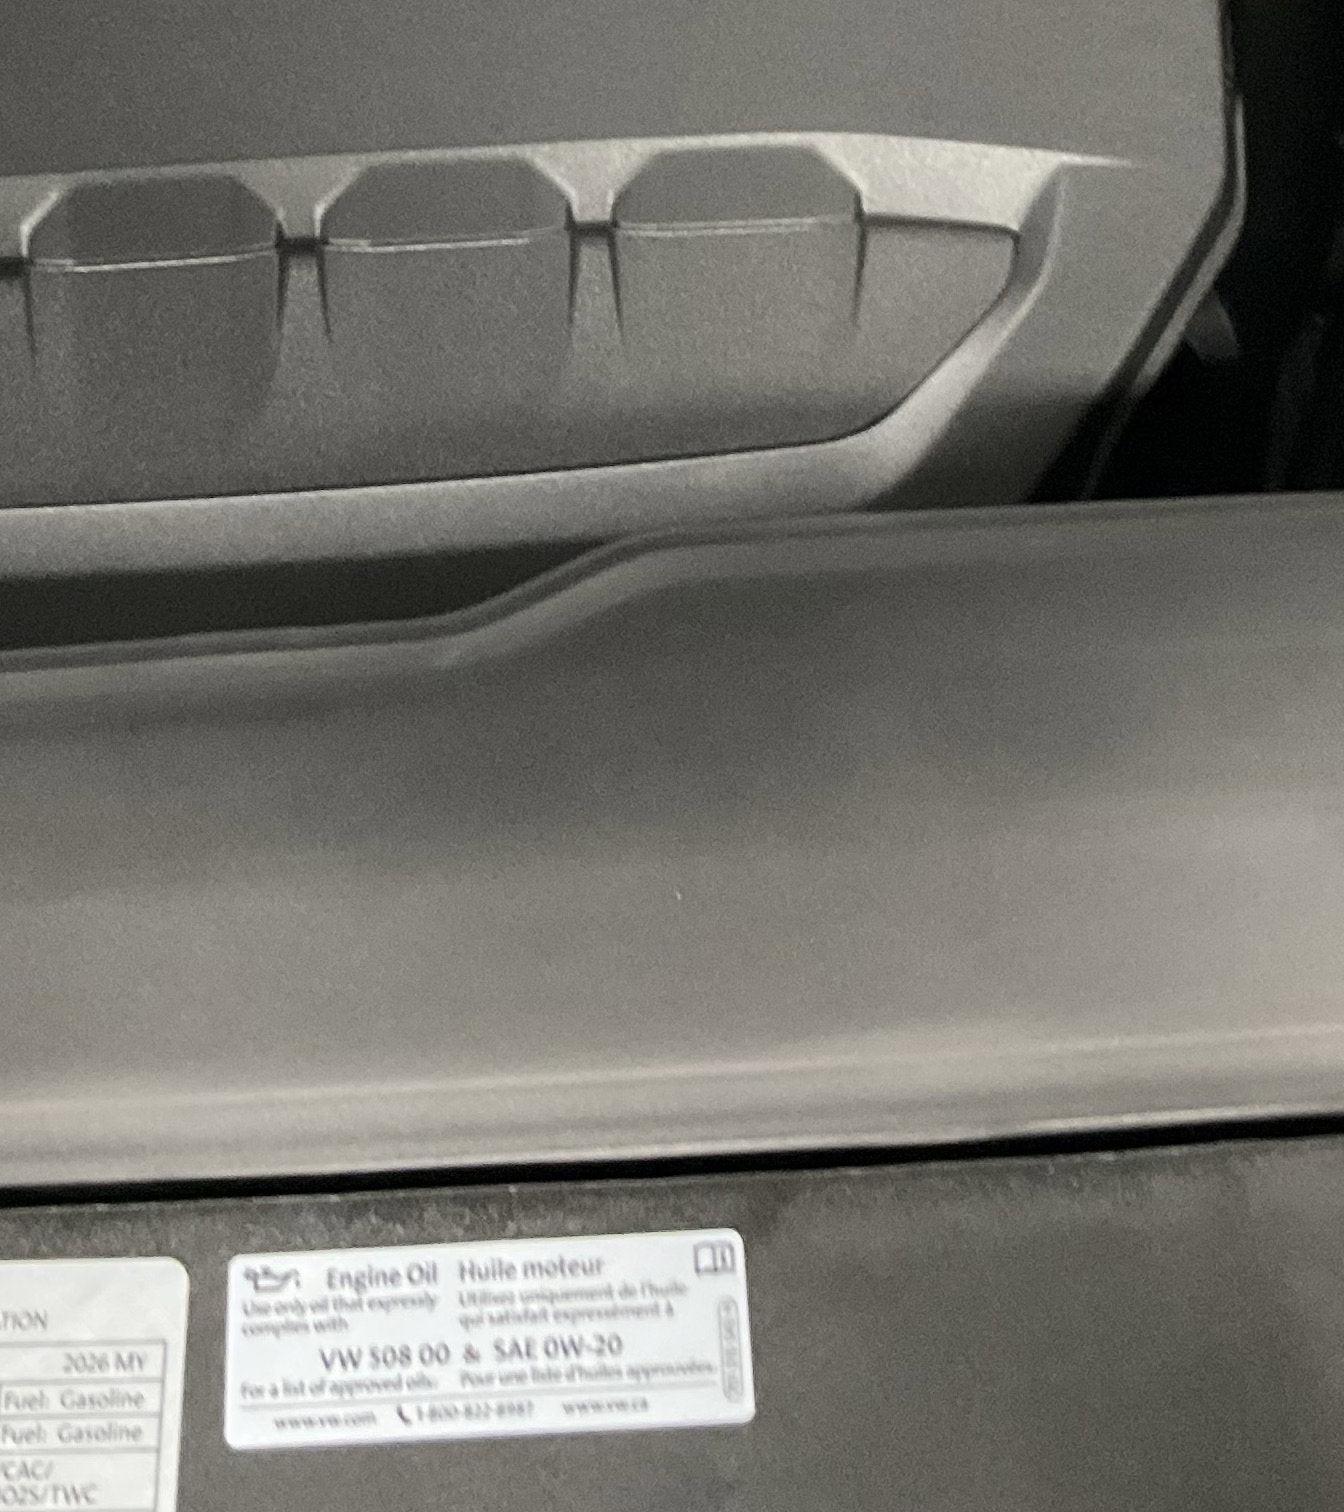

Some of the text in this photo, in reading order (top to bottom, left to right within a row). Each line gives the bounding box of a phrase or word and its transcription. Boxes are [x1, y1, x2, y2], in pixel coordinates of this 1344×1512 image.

[328, 1261, 437, 1295] Engine Oil
[459, 1251, 601, 1283] Huile moteur
[113, 1351, 148, 1372] MY
[319, 1332, 622, 1372] VW 508 00 & SAE 0W-20
[330, 1374, 401, 1397] approved
[58, 1387, 146, 1409] Gasoline
[56, 1421, 144, 1444] Gasoline
